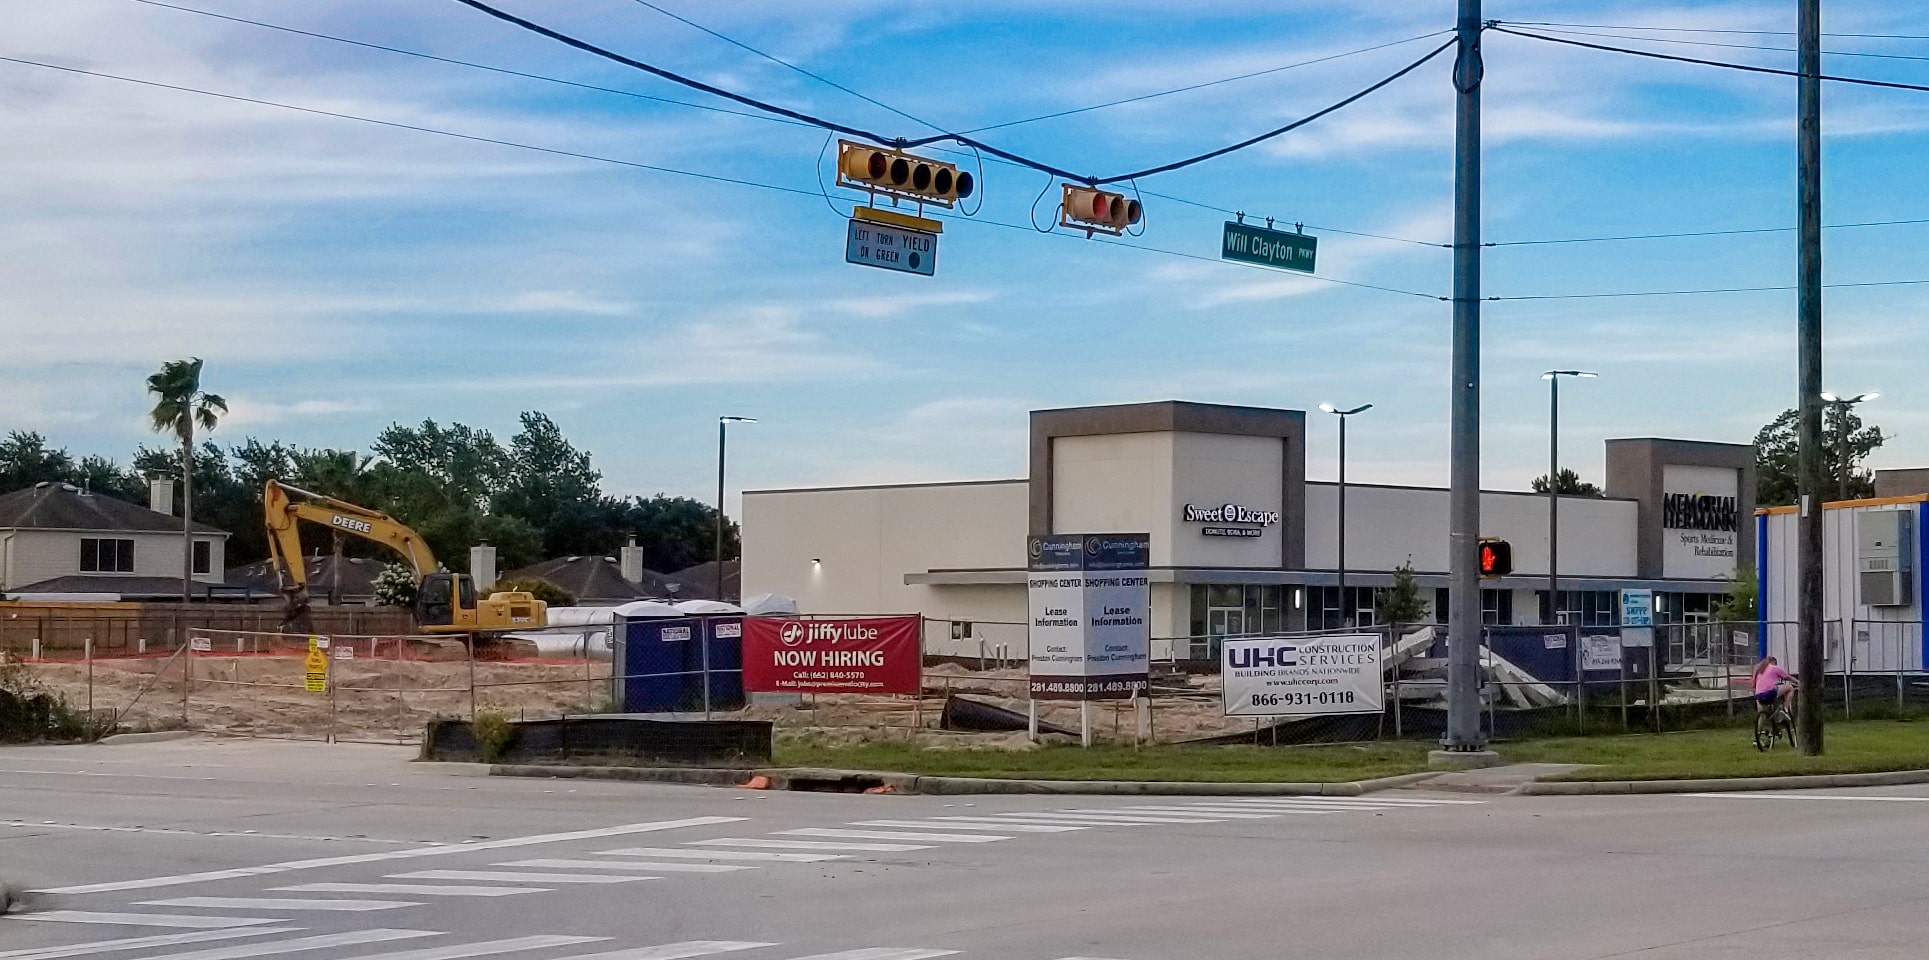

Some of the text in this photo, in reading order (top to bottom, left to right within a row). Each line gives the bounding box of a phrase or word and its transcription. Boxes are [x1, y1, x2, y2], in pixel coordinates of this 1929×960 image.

[855, 229, 930, 252] LEFT TURN YIELD
[1226, 231, 1314, 262] Will Clayton PKWY
[860, 246, 900, 263] ON GREEN
[1664, 492, 1736, 514] MEMORIAL
[1184, 504, 1279, 527] Sweet Escape
[1663, 510, 1737, 532] HERMANN
[332, 515, 371, 533] DEERE
[1680, 533, 1699, 546] Sports
[1727, 535, 1733, 545] &
[1043, 541, 1081, 551] Cunningham
[1102, 540, 1149, 551] Cunningham
[1694, 546, 1734, 557] Rehabilitation
[1029, 578, 1081, 588] SHOPPING CENTER
[1085, 577, 1148, 588] SHOPPING CENTER
[1045, 606, 1068, 616] Lease
[1103, 605, 1130, 615] Lease
[1035, 617, 1078, 627] Information
[1091, 616, 1143, 627] Information
[774, 650, 884, 667] NOW HIRING
[1228, 643, 1375, 668] UHC CONSTRUCTION
[1300, 653, 1375, 666] SERVICES
[793, 671, 865, 680] Call: (662) 840-5570
[1234, 667, 1360, 678] BUILDING BRANDS NATIONWIDE
[1031, 682, 1084, 693] 281.489.8800
[1266, 678, 1339, 687] www.uhccorp.com
[1251, 690, 1354, 707] 866-931-0118
